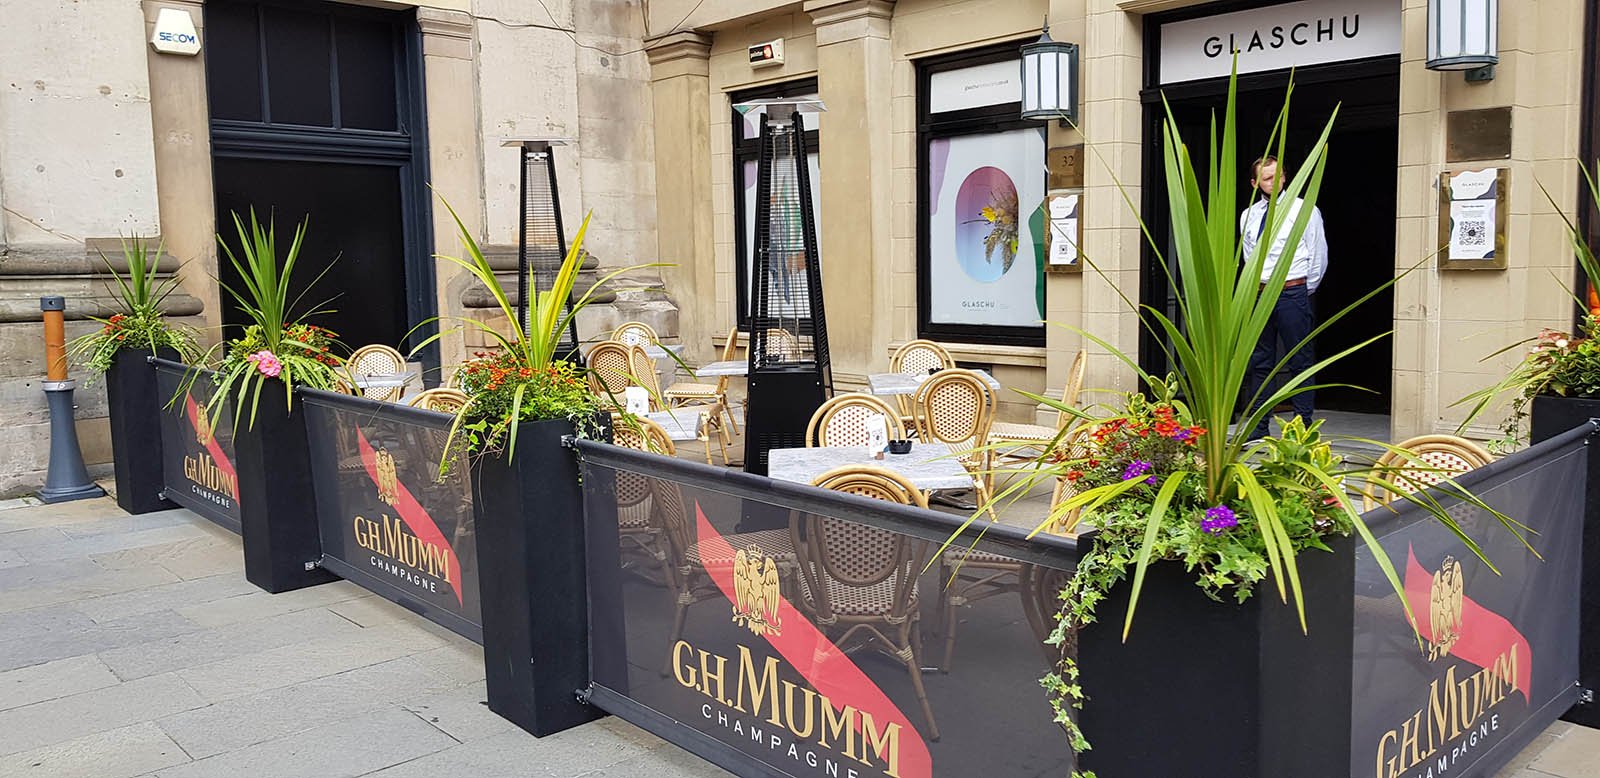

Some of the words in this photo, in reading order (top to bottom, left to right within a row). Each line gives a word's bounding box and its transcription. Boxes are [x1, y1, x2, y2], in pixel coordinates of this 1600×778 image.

[159, 31, 196, 45] SECOM
[1203, 14, 1360, 58] GLASCHU
[1062, 155, 1074, 167] 32
[961, 300, 996, 308] GLASCHU
[191, 484, 231, 509] CHAMPAGNE
[370, 556, 437, 593] CHAMPAGNE
[1418, 713, 1500, 778] AMPAGNE
